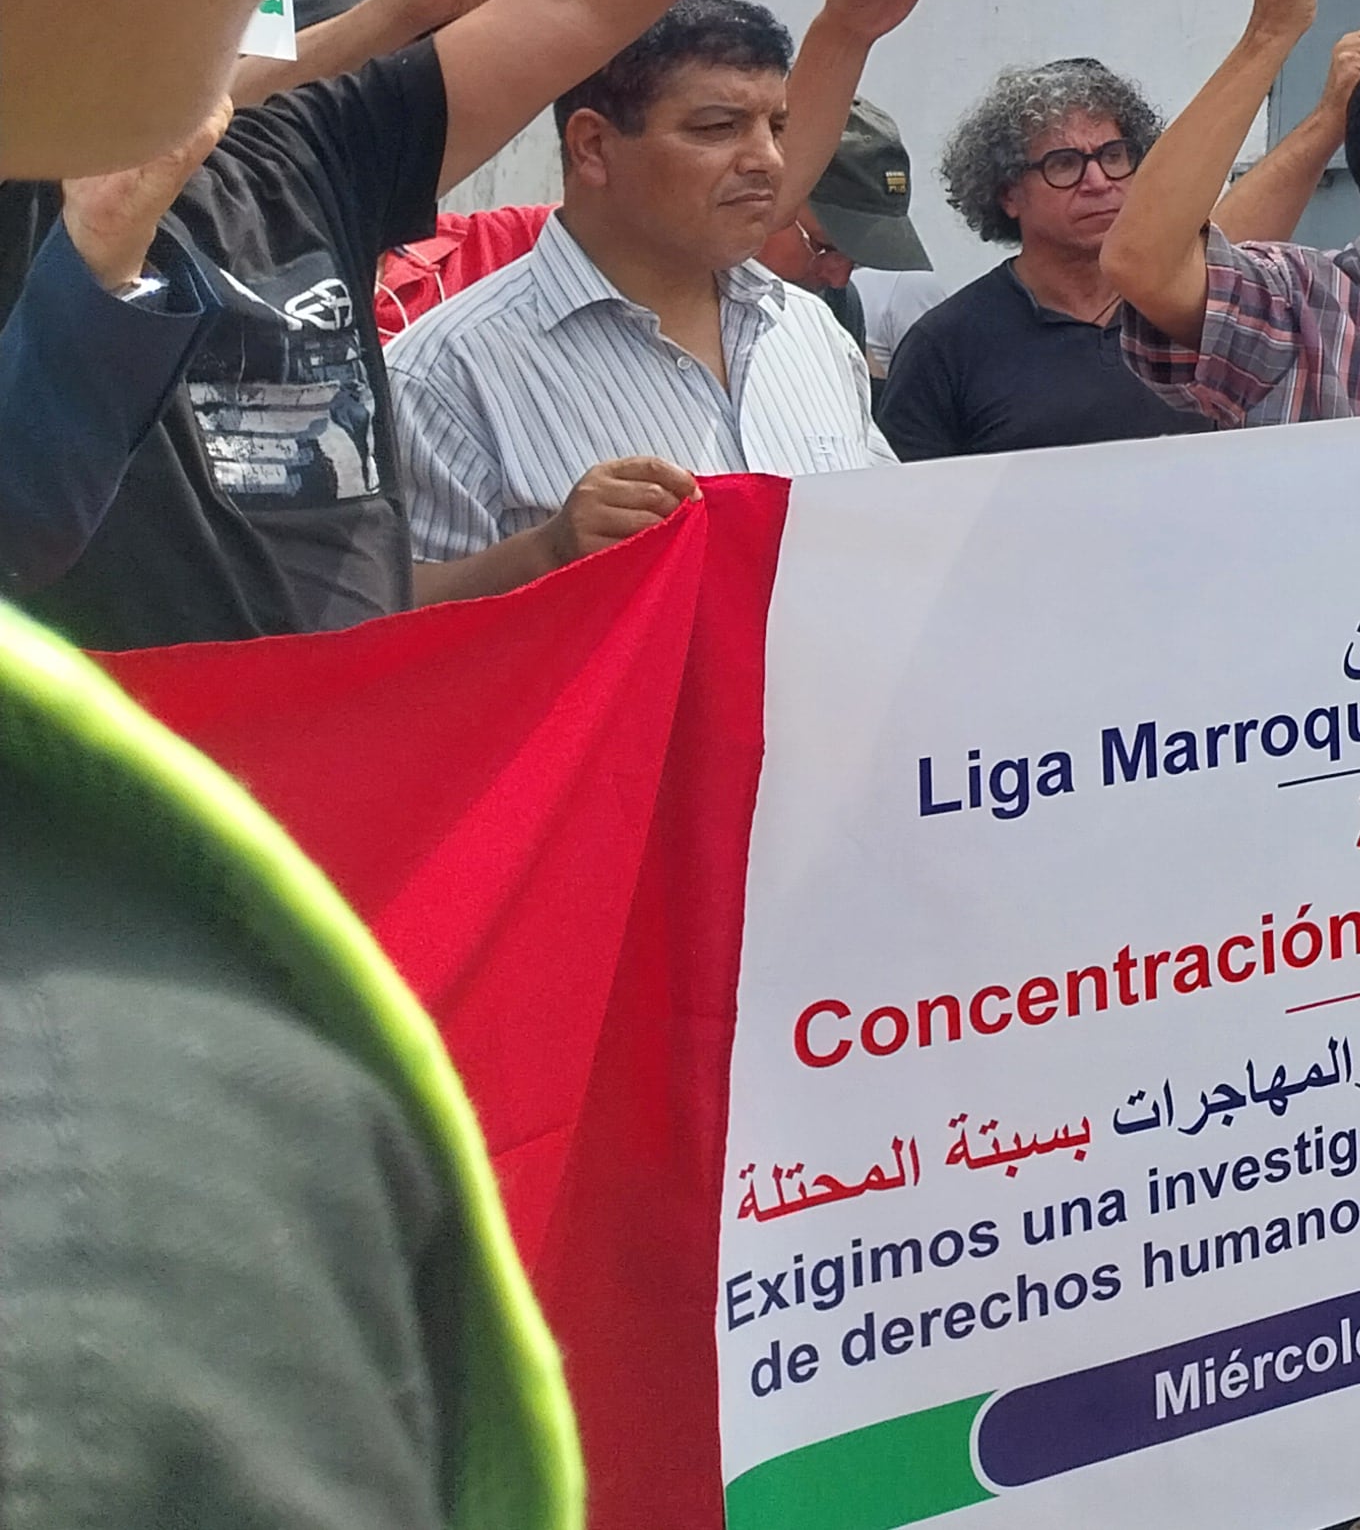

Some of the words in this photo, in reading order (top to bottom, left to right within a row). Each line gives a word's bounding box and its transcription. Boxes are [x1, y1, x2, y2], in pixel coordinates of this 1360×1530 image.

[918, 749, 1075, 820] Liga
[737, 1138, 920, 1223] المحتلة
[945, 1114, 1091, 1177] بسبتة
[726, 1220, 1000, 1331] Exigimos
[1023, 1189, 1128, 1246] una
[751, 1340, 819, 1397] de
[841, 1263, 1122, 1367] derechos
